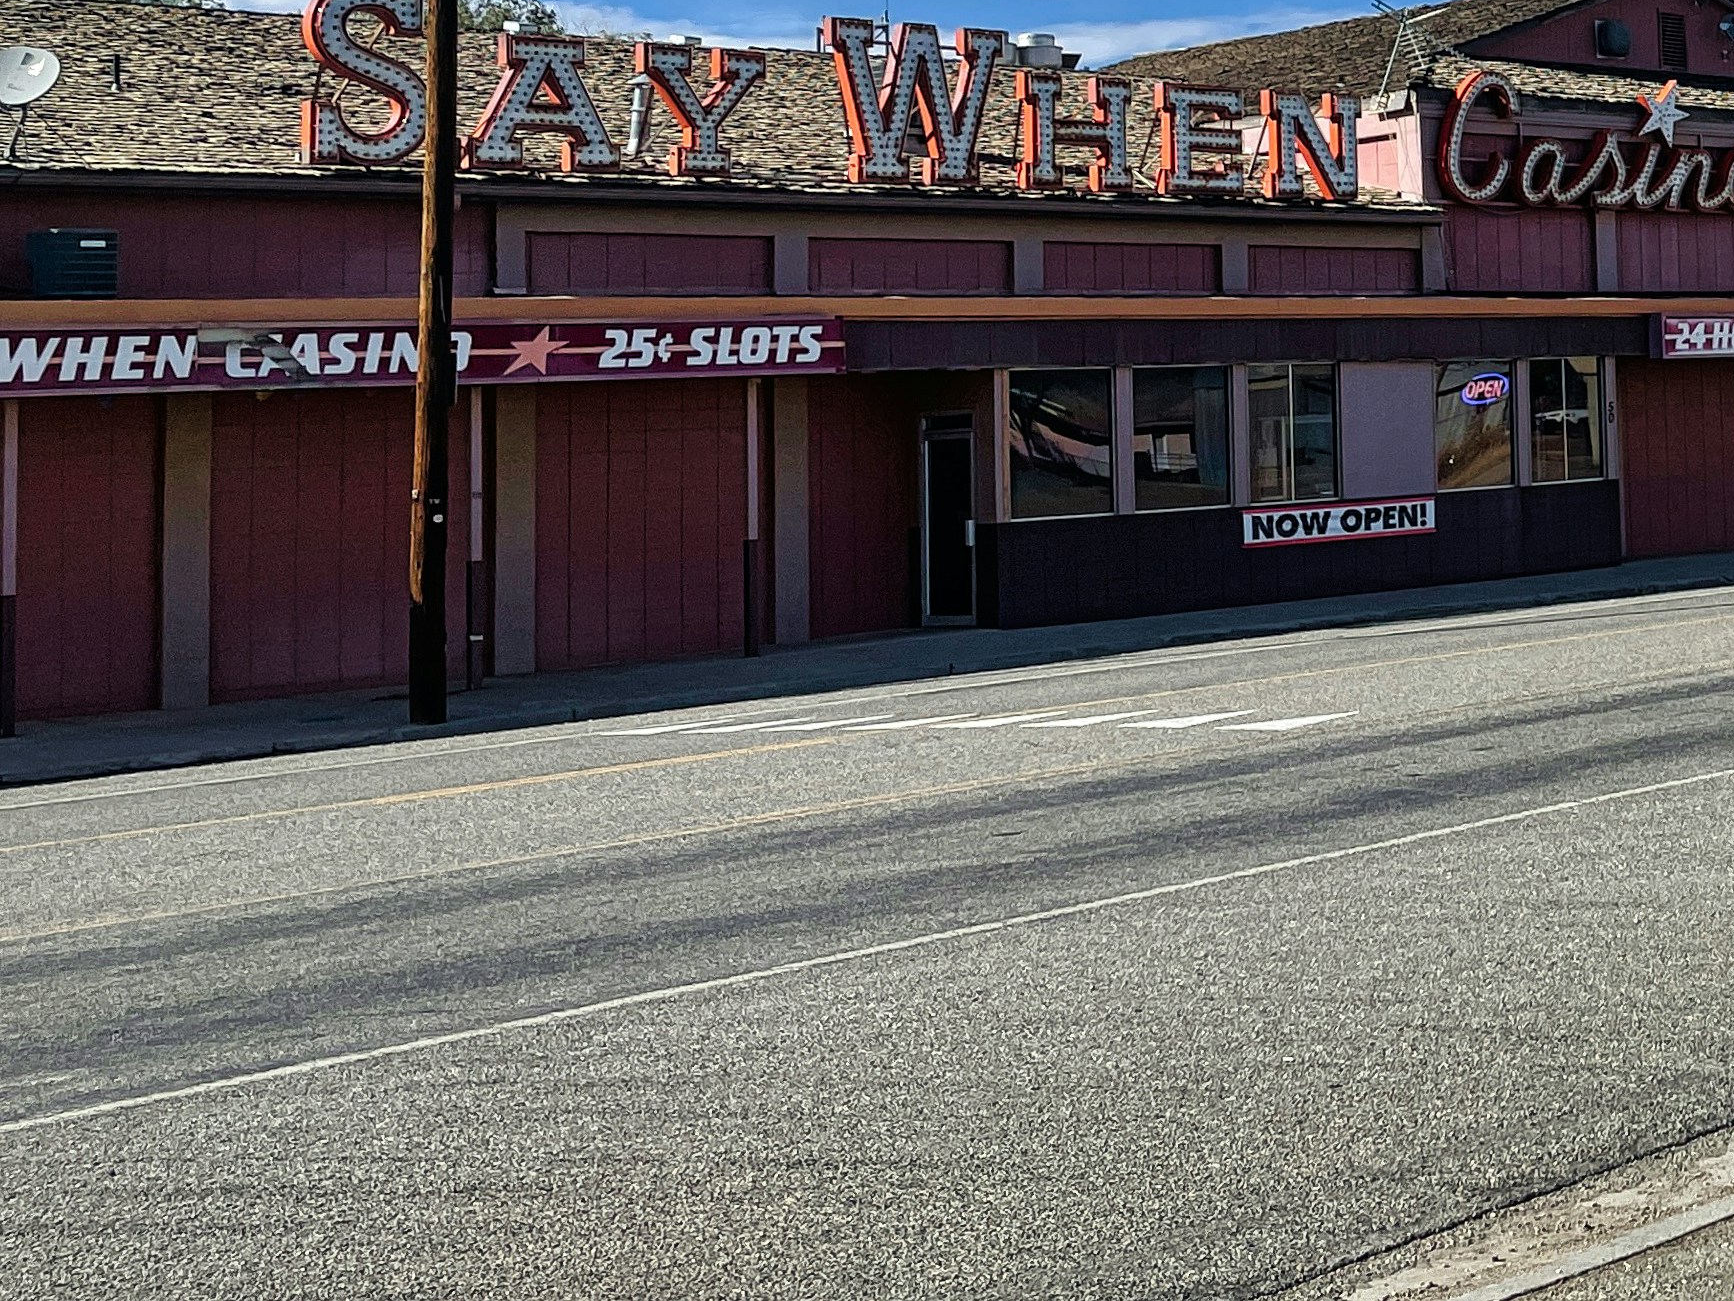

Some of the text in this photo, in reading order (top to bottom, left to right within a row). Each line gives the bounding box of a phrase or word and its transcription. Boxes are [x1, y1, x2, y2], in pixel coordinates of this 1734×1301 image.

[822, 17, 1361, 200] WHEN
[686, 325, 824, 366] SLOTS
[1675, 322, 1706, 350] 24
[0, 335, 198, 383] WHEN
[1465, 380, 1503, 399] OPEN
[1252, 503, 1427, 540] NOW OPEN!
